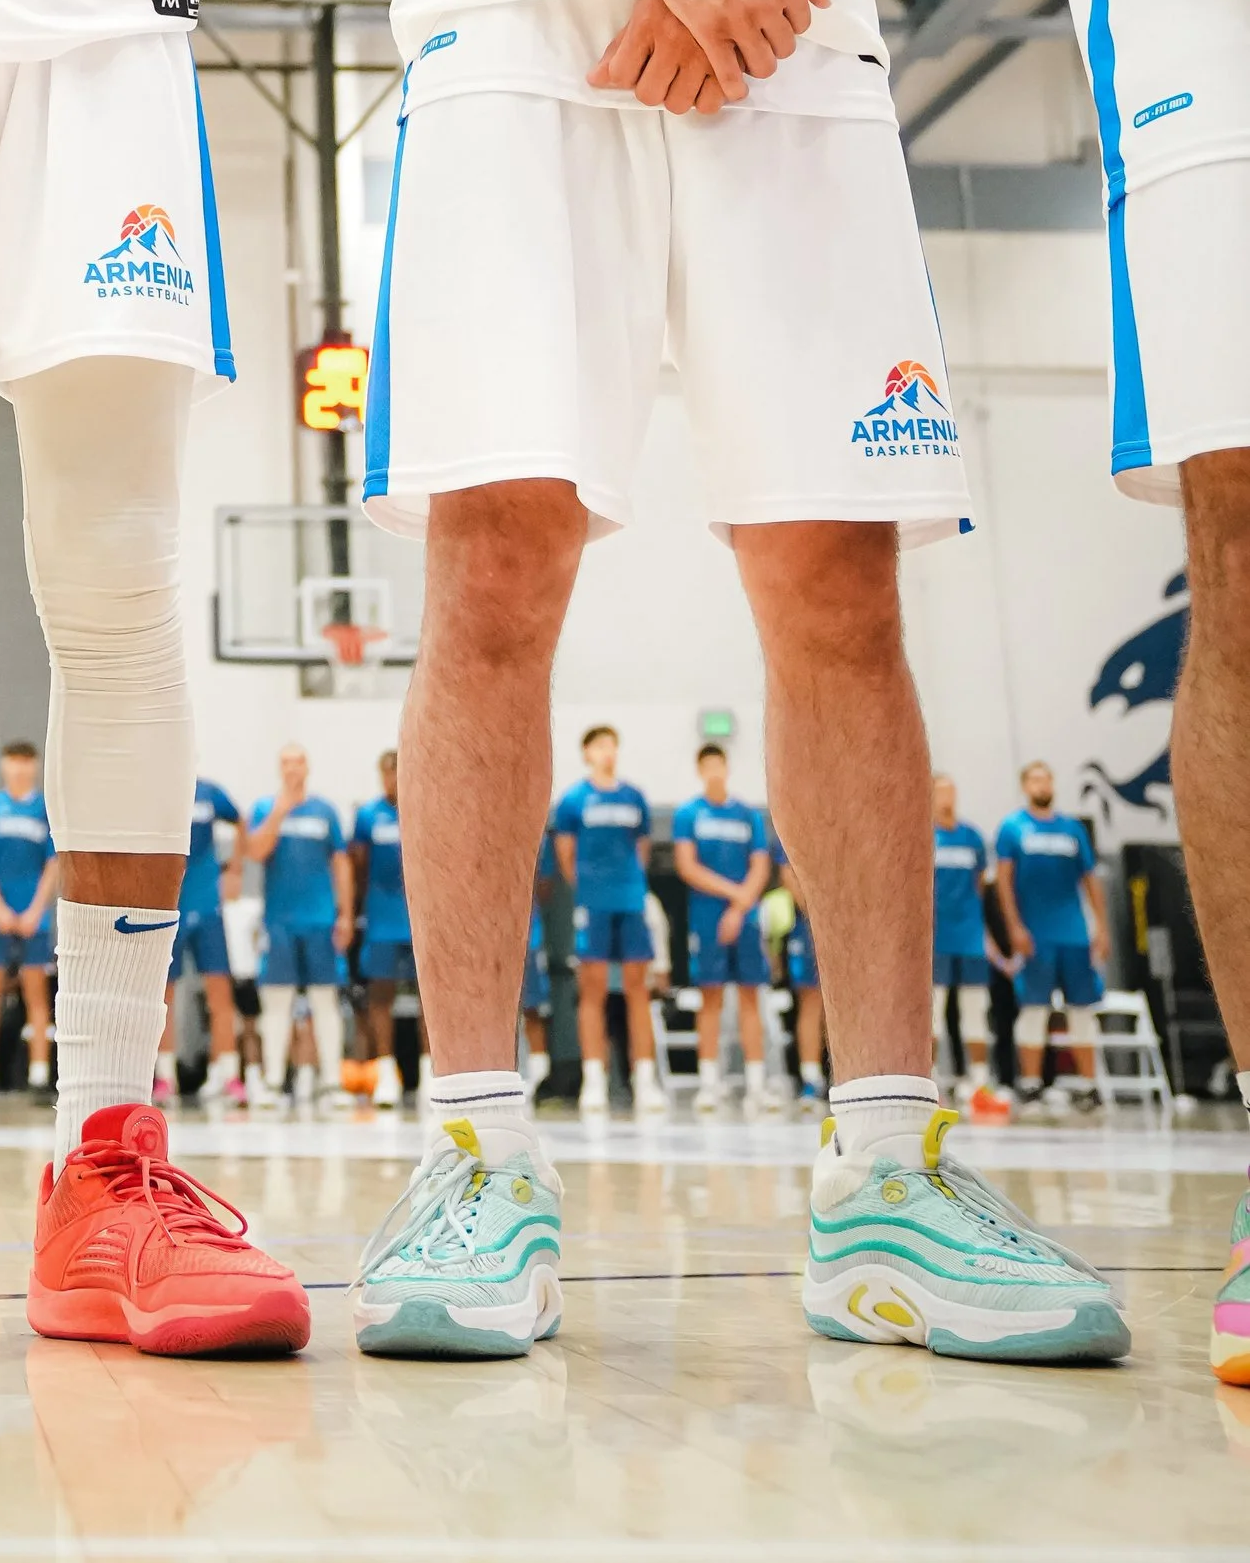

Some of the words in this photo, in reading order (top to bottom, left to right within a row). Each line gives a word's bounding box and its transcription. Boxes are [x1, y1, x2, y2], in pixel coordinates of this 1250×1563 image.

[83, 260, 195, 293] ARMENIA
[97, 285, 190, 306] BASKETBALL
[864, 444, 961, 458] BASKETBALL
